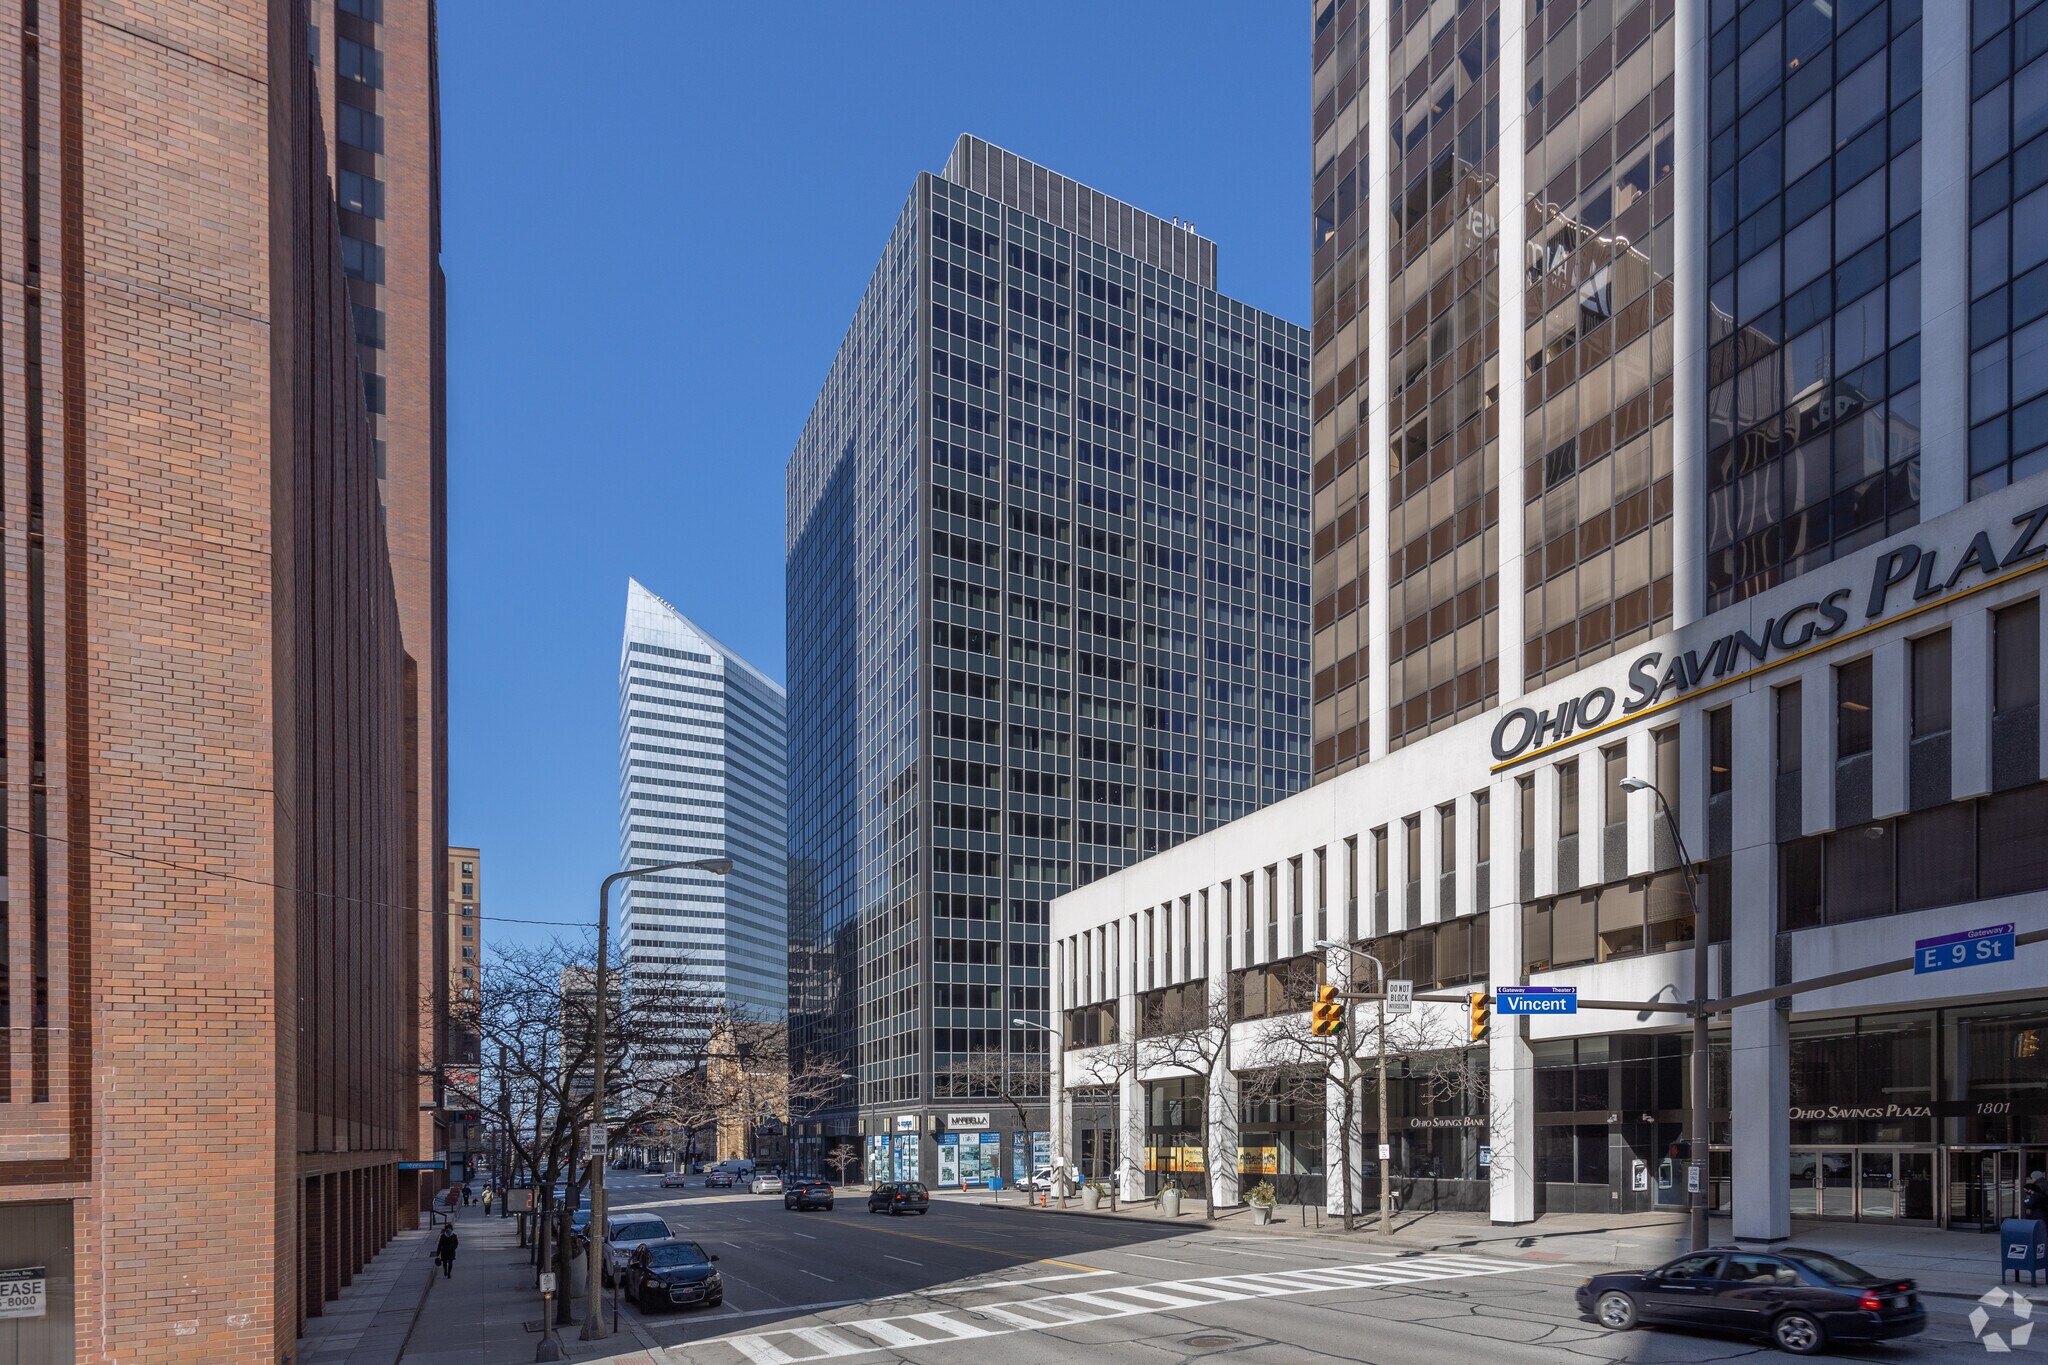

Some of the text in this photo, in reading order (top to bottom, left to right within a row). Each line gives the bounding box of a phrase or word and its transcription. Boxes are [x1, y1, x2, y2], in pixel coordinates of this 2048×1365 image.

[1490, 686, 1614, 761] OHIO
[1623, 588, 1852, 714] SAVINGS
[1967, 926, 2004, 938] Gateway
[1924, 940, 2002, 968] E. 9 St
[1390, 984, 1410, 993] DO NOT
[1390, 993, 1409, 1002] BLOCK
[1507, 996, 1567, 1011] Vincent
[1788, 1104, 1932, 1119] OHIO SAVINGS PLAZA
[1976, 1102, 2011, 1115] 1801
[951, 1116, 988, 1125] MARBELLA
[1410, 1116, 1486, 1128] OHIO SAVINGS BANK
